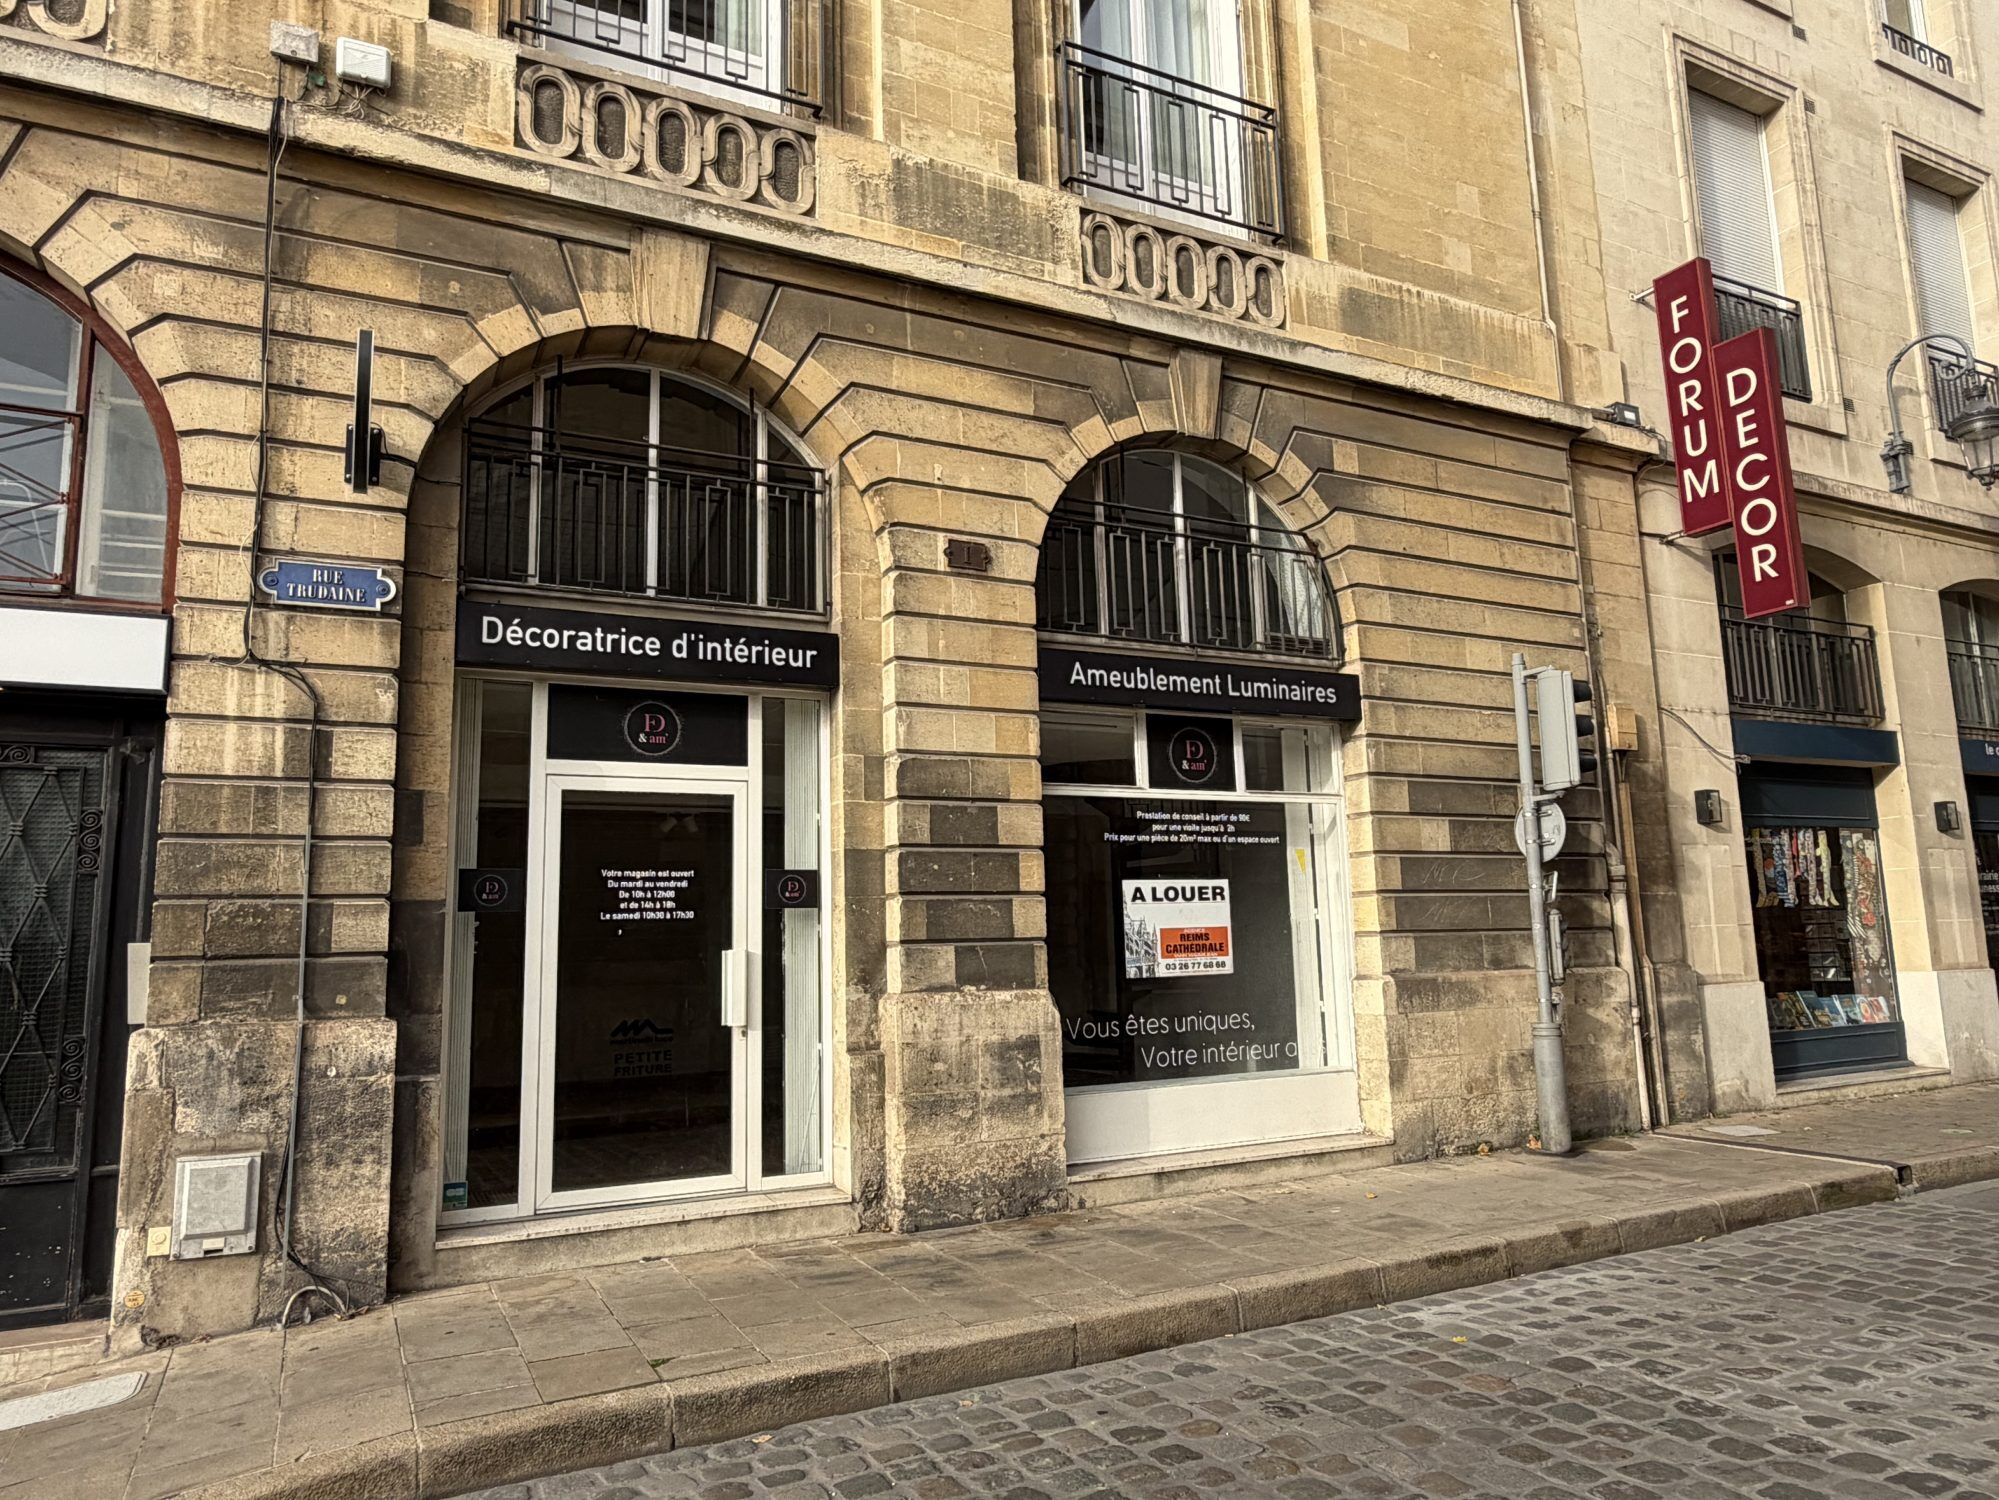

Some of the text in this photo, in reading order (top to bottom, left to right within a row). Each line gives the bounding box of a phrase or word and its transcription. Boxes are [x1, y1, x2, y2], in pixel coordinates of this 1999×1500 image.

[1669, 295, 1720, 503] FORUM
[1726, 367, 1779, 582] DECOR
[312, 568, 343, 585] RUE
[286, 583, 367, 602] TRUDAINE
[481, 615, 818, 668] Décoratrice d'intérieur
[1070, 661, 1337, 704] Ameublement Luminaires
[1984, 743, 1995, 756] le
[1136, 811, 1171, 820] Prestation
[1172, 812, 1180, 820] de
[1181, 812, 1204, 821] conseil
[1205, 813, 1210, 821] à
[1211, 813, 1228, 823] partir
[1229, 814, 1238, 822] de
[1152, 824, 1168, 832] pour
[1182, 823, 1200, 832] visite
[1226, 824, 1236, 832] 2h
[1104, 832, 1119, 841] Prix
[1119, 834, 1136, 843] pour
[1151, 833, 1169, 843] pièce
[1169, 834, 1178, 842] de
[1222, 835, 1237, 843] d'un
[1237, 836, 1259, 845] espace
[1259, 836, 1280, 844] ouvert
[601, 869, 695, 879] Votre magasin est ouvert
[607, 880, 619, 888] Du
[620, 880, 644, 888] mardi
[655, 879, 689, 888] vendredi
[619, 890, 676, 898] De 10h à 12h00
[1131, 885, 1226, 902] A LOUER
[620, 901, 676, 909] et de 14h à 18h
[600, 910, 695, 920] Le samedi 10h30 à 17h30
[1180, 932, 1210, 942] REIMS
[1165, 960, 1227, 971] 03 26 77 68 68
[1066, 1010, 1255, 1040] Vous êtes uniques,
[614, 1049, 672, 1064] PETITE
[1141, 1046, 1197, 1068] Votre
[1202, 1040, 1281, 1063] intérieur
[614, 1063, 672, 1076] FRITURE
